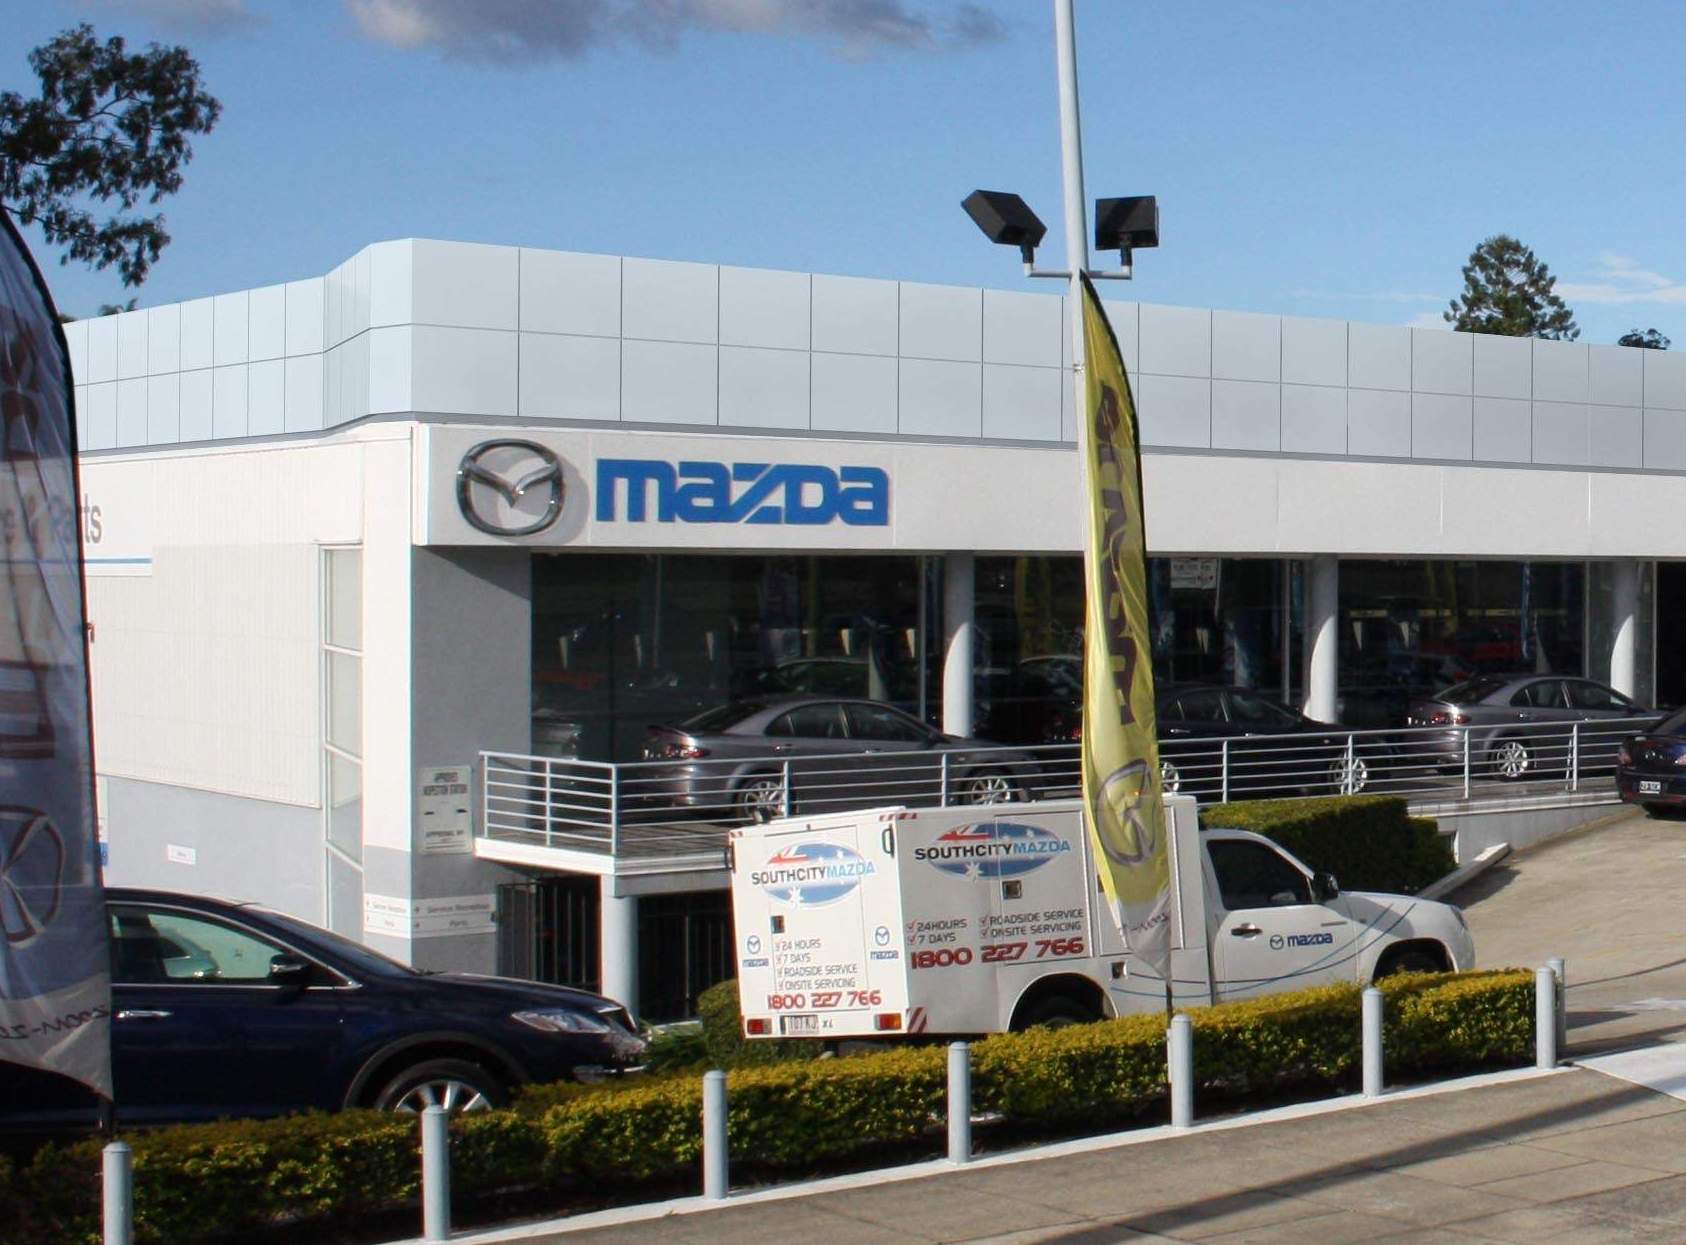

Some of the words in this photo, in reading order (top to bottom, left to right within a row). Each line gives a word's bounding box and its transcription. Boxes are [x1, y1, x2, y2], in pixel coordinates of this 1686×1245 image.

[597, 459, 889, 526] mazda
[990, 912, 1040, 925] ROADSIDE
[1043, 909, 1084, 920] SERVICE
[991, 926, 1026, 938] ONSITE
[1031, 921, 1081, 934] SERVICING
[782, 941, 793, 951] 24
[795, 939, 822, 950] HOURS
[919, 936, 925, 944] 7
[929, 933, 956, 943] DAYS
[1287, 933, 1333, 947] mazda
[790, 953, 811, 963] DAYS
[911, 947, 972, 969] 1800
[981, 942, 1028, 963] 227
[1035, 937, 1084, 958] 766
[784, 966, 823, 977] ROADSIDE
[825, 964, 857, 976] SERVICE
[785, 980, 812, 990] ONSITE
[815, 978, 856, 989] SERVICING
[768, 994, 806, 1010] 1800
[811, 993, 842, 1008] 227
[847, 990, 882, 1006] 766
